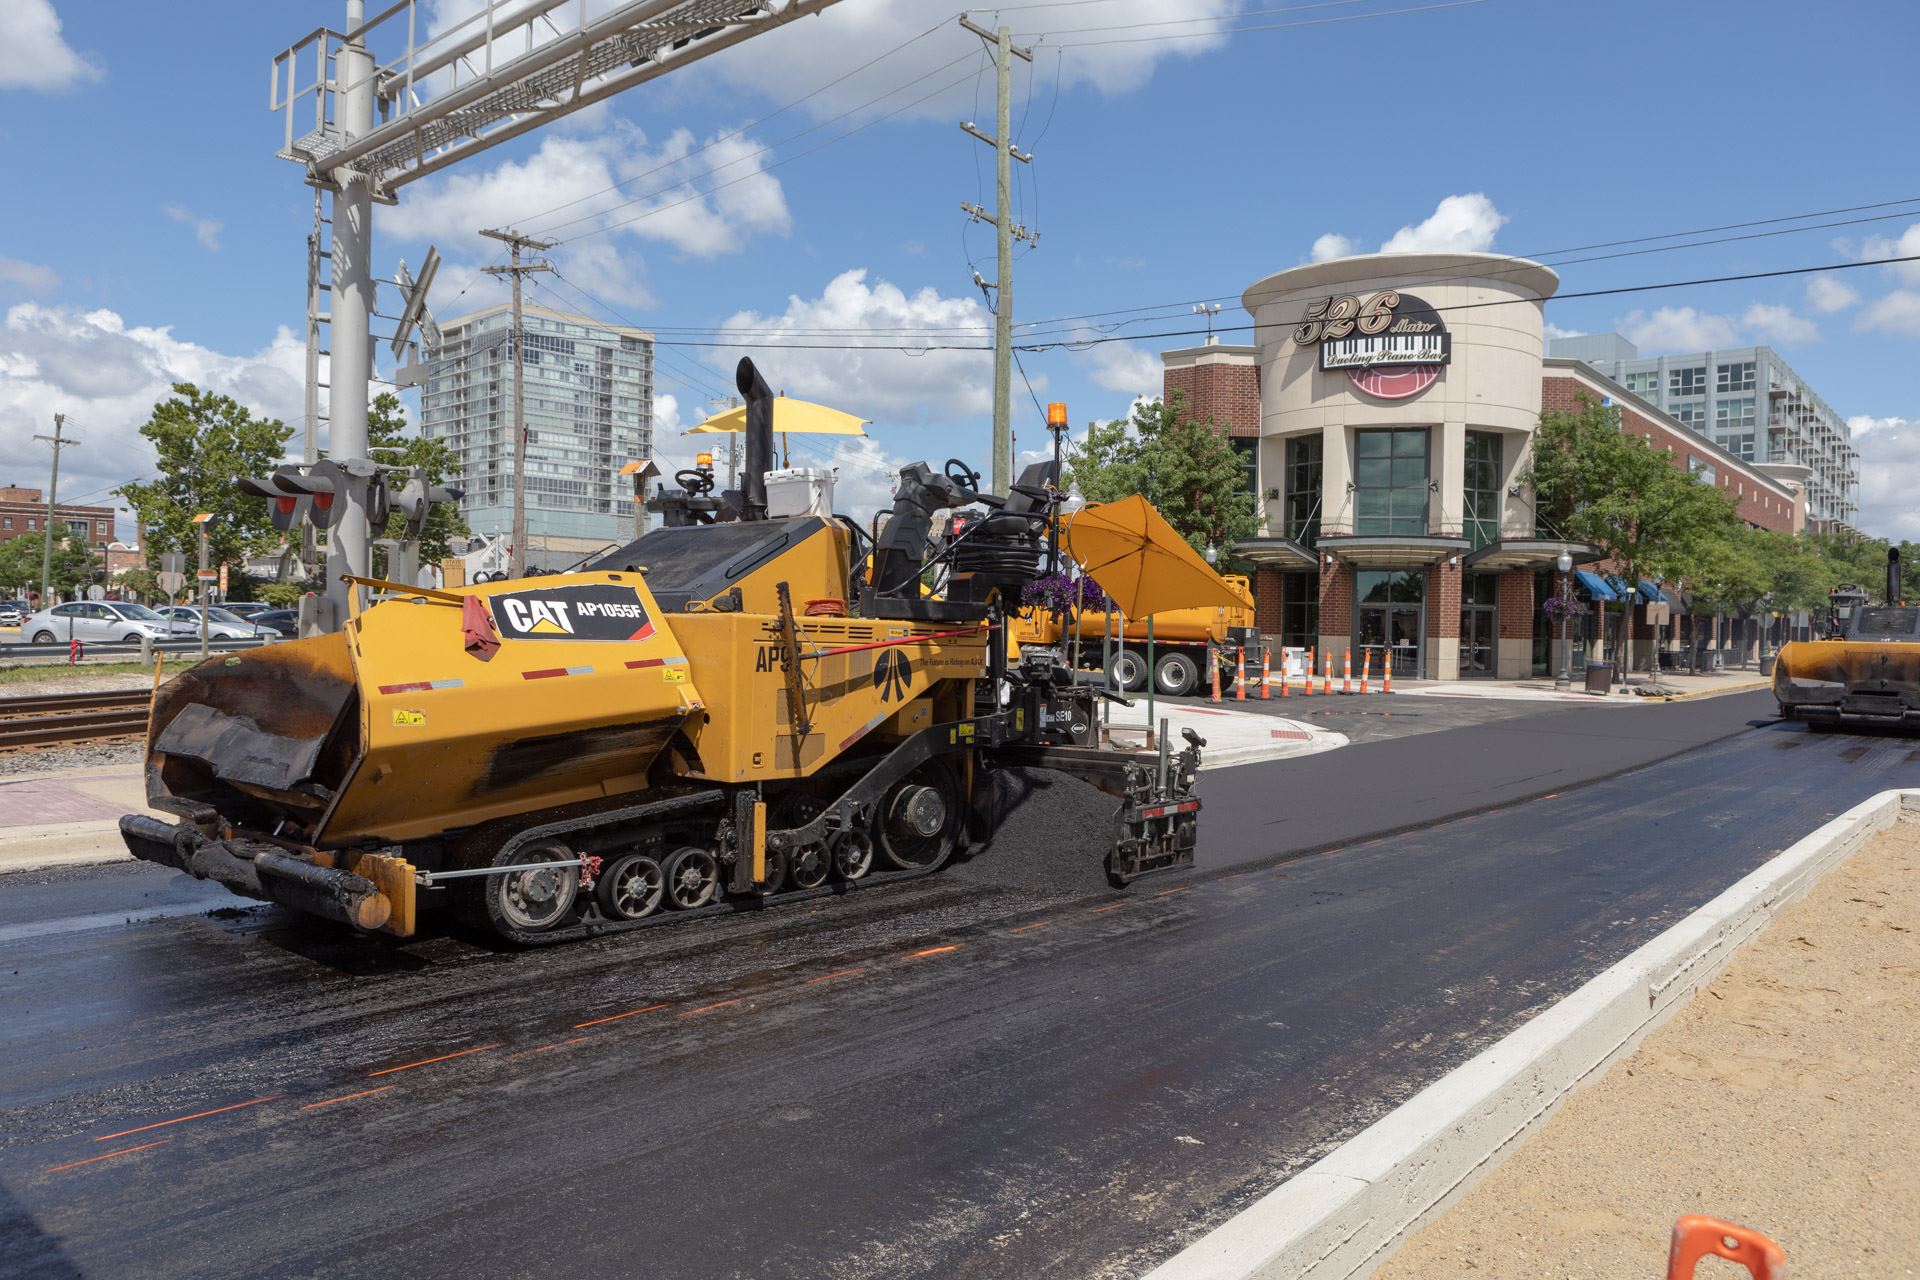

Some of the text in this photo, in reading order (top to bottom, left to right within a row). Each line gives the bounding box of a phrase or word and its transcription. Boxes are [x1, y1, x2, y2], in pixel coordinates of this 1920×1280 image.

[1292, 289, 1400, 346] 526
[1390, 318, 1437, 334] Main
[1326, 348, 1448, 368] Dueling Piano Bar
[503, 598, 575, 634] CAT
[576, 602, 642, 618] AP1055F
[1055, 710, 1072, 722] SE10
